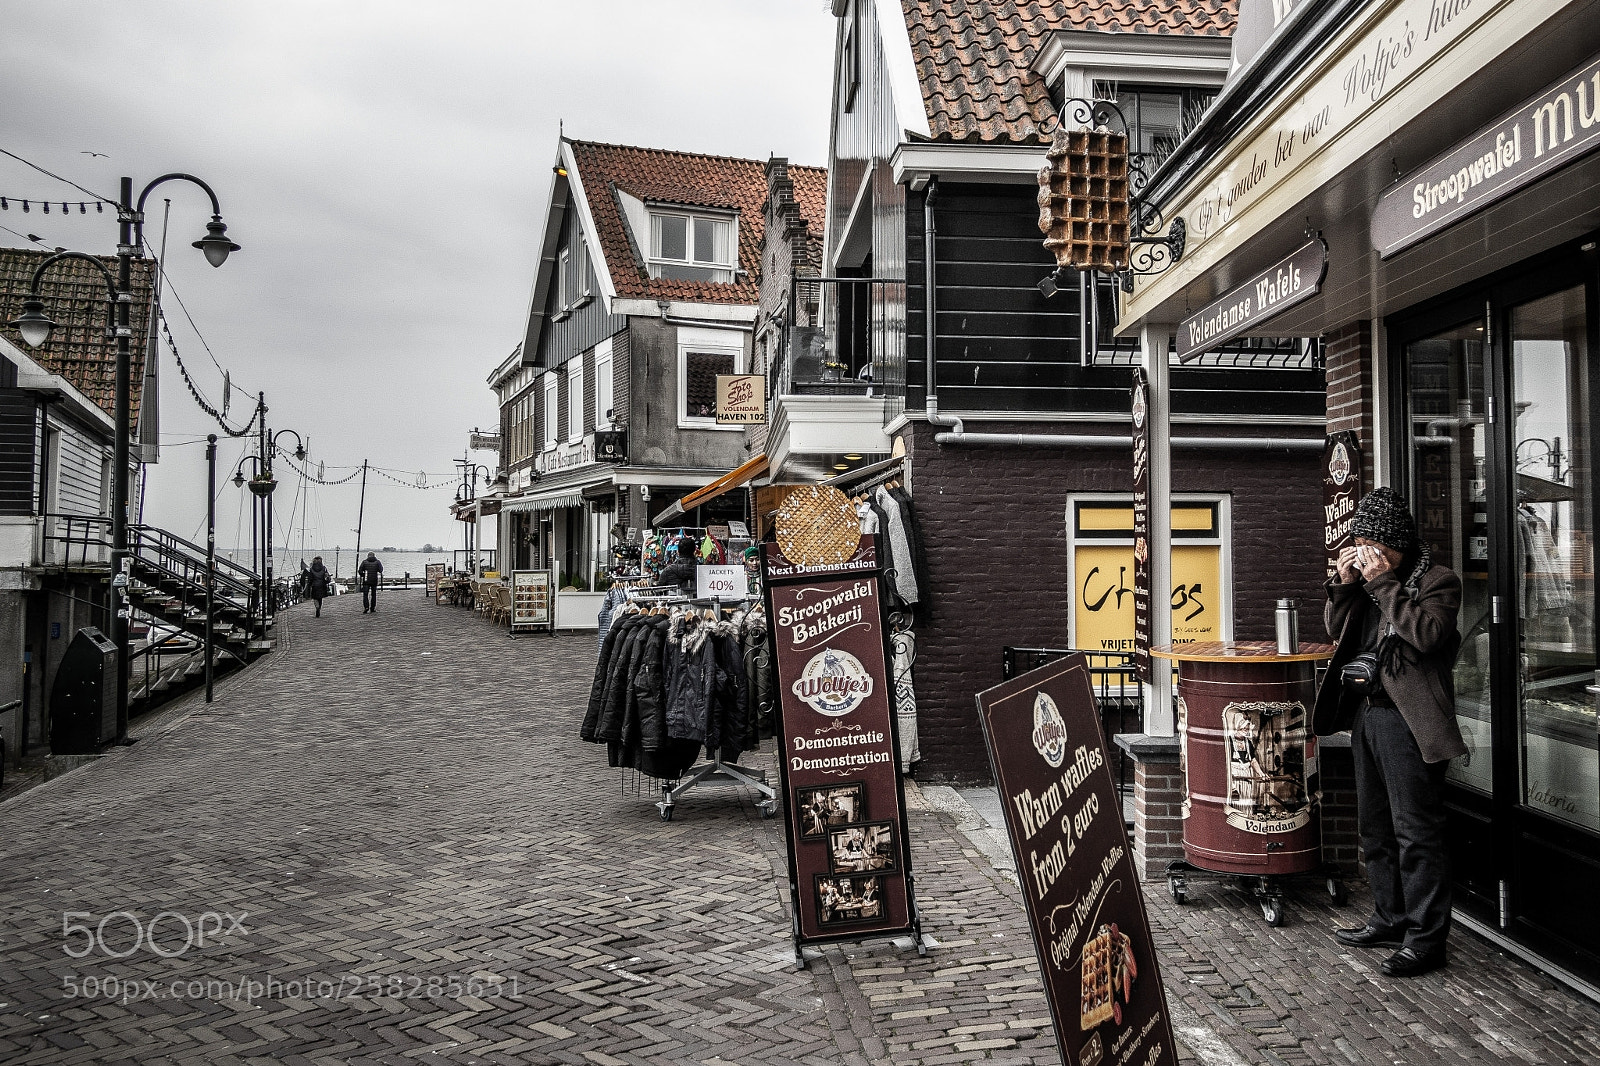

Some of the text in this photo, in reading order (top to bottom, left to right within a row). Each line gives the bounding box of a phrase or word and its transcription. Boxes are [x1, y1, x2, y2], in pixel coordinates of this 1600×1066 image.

[1224, 153, 1267, 222] gouden
[1302, 104, 1330, 144] van
[1343, 20, 1416, 108] Woltje's
[1412, 123, 1521, 219] Stroopwafel
[1189, 262, 1301, 347] Volendamse Wafels
[728, 376, 752, 391] Foto
[728, 390, 753, 405] Shop
[717, 413, 765, 421] HAVEN 102
[1324, 496, 1354, 524] Waffle
[1325, 518, 1353, 545] Baker
[767, 560, 876, 576] Next Demonstration
[708, 580, 735, 591] 40%
[778, 580, 873, 627] Stroopwafel
[791, 605, 863, 644] Bakkerij
[796, 676, 870, 698] Woltje's
[793, 731, 884, 751] Demonstratie
[791, 751, 890, 771] Demonstration
[1013, 744, 1103, 841] Warm waffles
[1245, 820, 1297, 833] Volendam
[1030, 792, 1099, 900] from 2 euro
[1050, 912, 1079, 970] Original
[1101, 845, 1124, 878] Waffles
